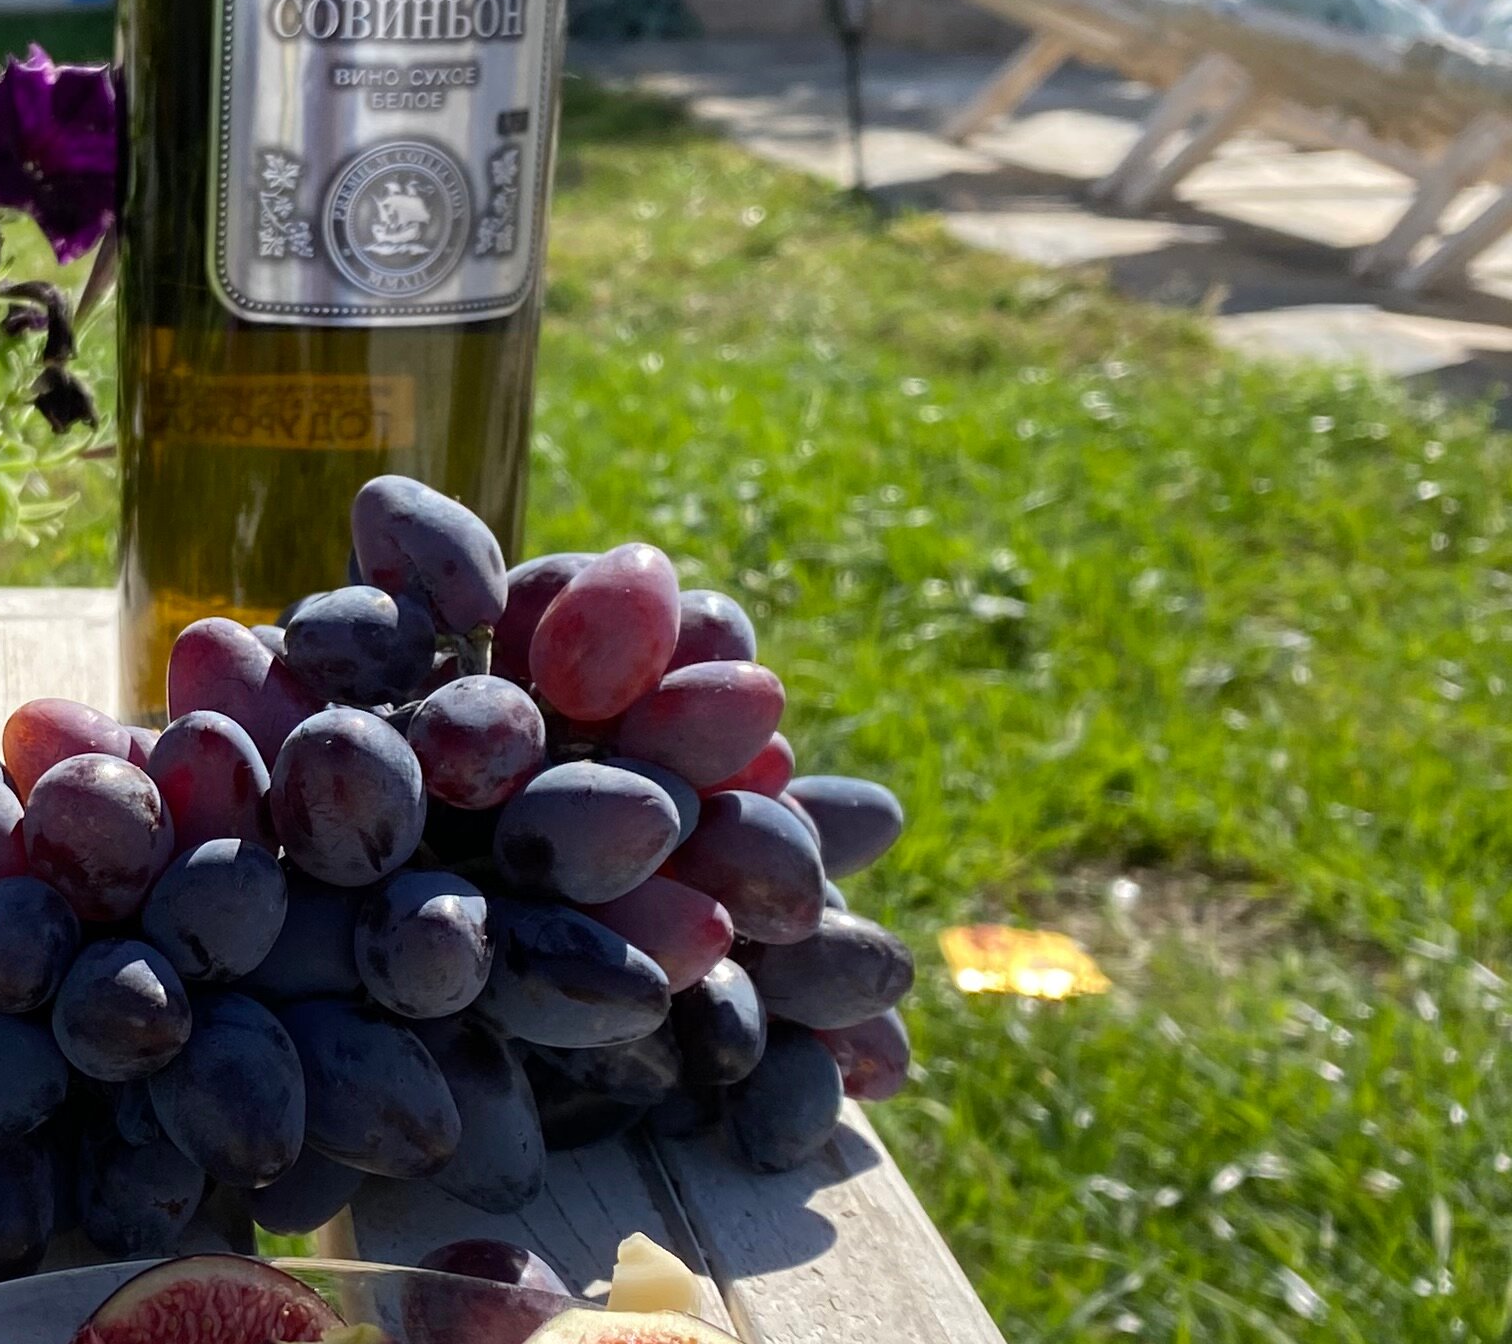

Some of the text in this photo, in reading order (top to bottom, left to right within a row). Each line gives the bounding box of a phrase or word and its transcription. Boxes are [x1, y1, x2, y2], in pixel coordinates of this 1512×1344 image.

[334, 67, 477, 86] ВИНО СУХОЕ
[371, 91, 443, 109] БЕЛОЕ
